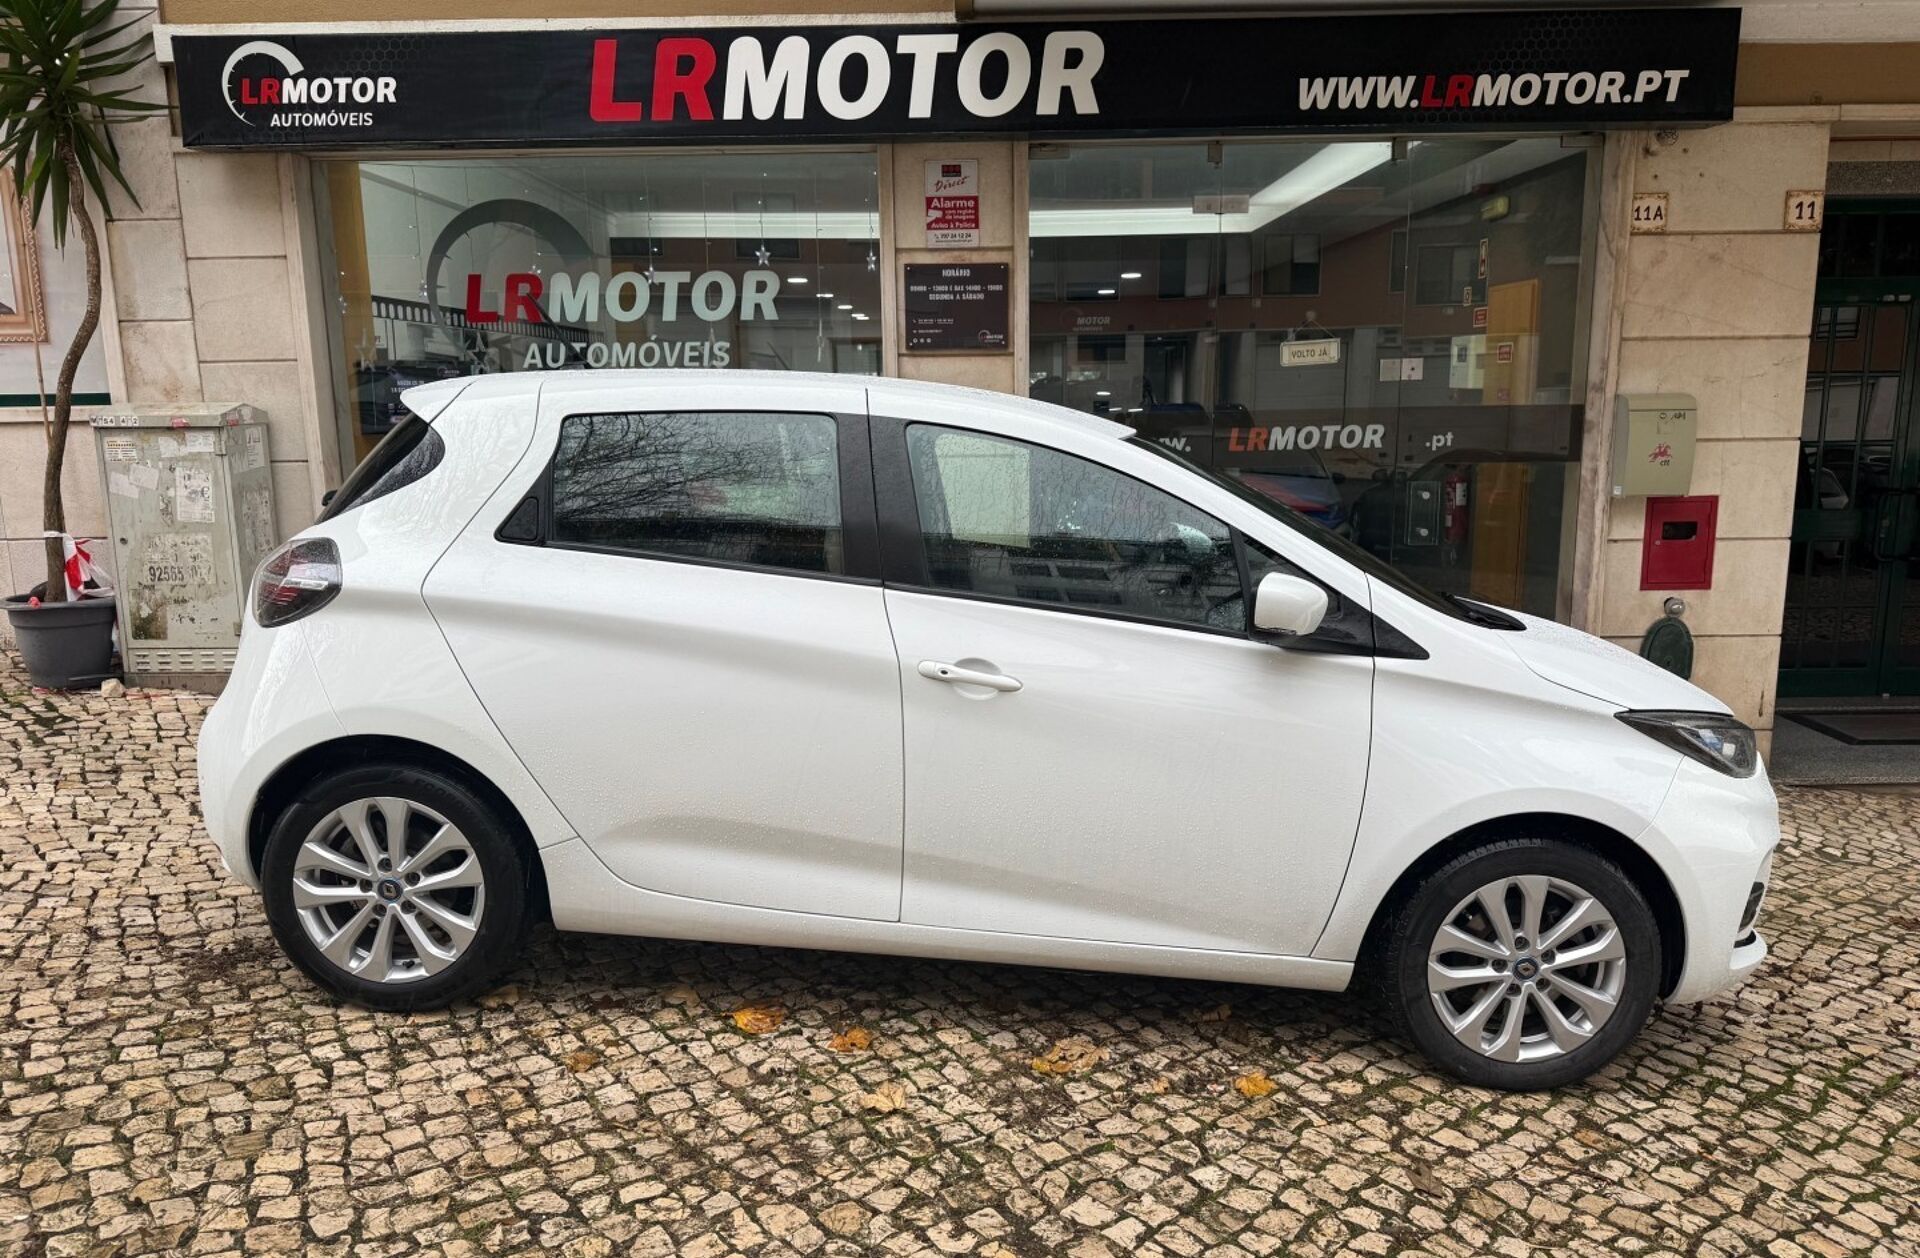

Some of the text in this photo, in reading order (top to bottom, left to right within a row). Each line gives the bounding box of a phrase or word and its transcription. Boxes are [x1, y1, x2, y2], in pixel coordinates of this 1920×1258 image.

[589, 31, 1105, 122] LRMOTOR
[1298, 69, 1690, 110] WWW.LRMOTOR.PT
[241, 77, 397, 105] LRMOTOR
[270, 110, 373, 127] AUTOMÓVEIS
[931, 198, 975, 208] Alarme
[1634, 205, 1663, 221] 11A
[1795, 201, 1816, 220] 11
[466, 270, 780, 324] LRMOTOR
[523, 334, 731, 369] AUTOMÓVEIS
[1291, 348, 1316, 359] VOLTO
[1228, 424, 1385, 452] LRMOTOR
[1425, 432, 1454, 450] .pt
